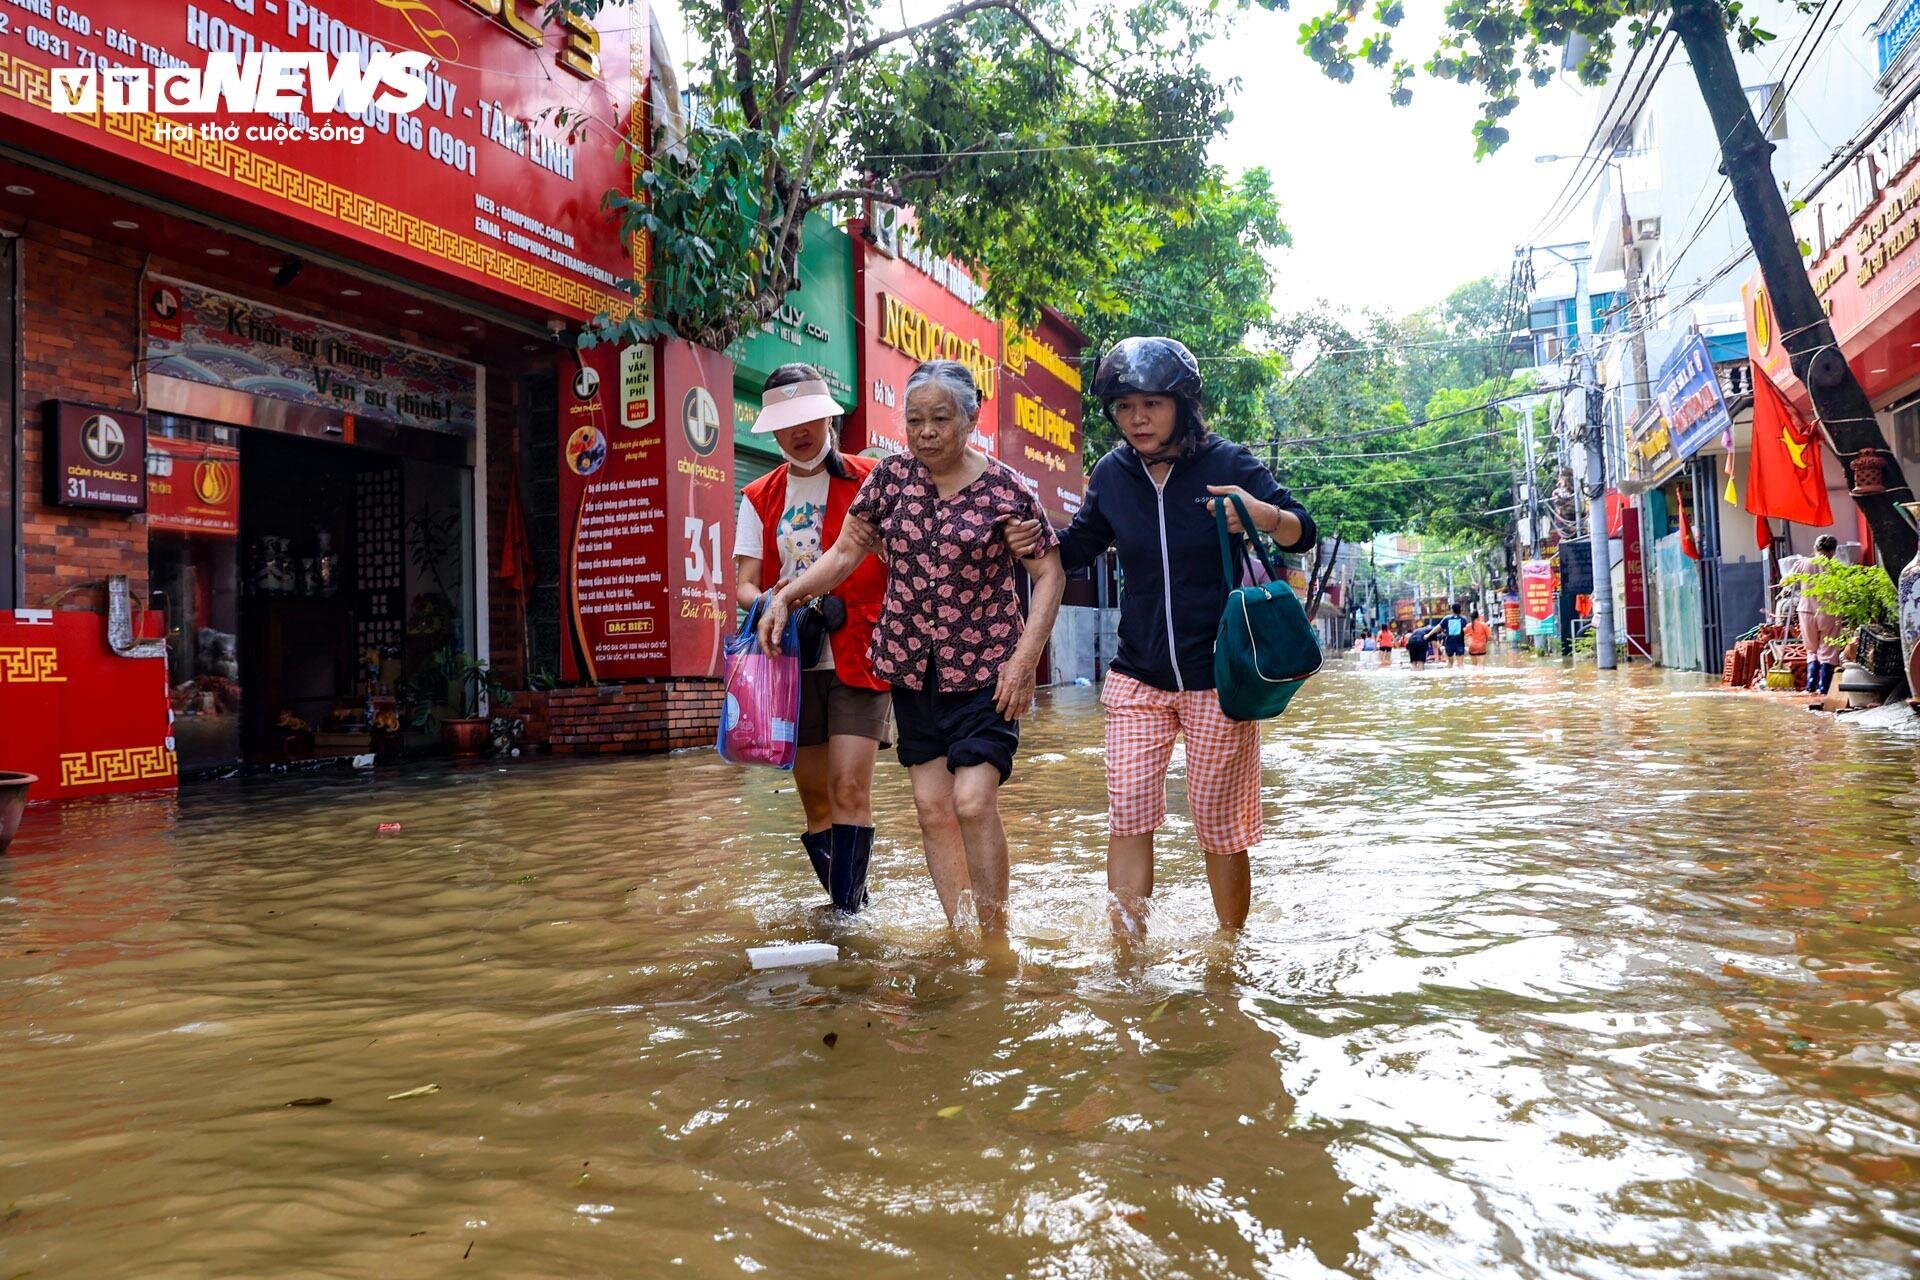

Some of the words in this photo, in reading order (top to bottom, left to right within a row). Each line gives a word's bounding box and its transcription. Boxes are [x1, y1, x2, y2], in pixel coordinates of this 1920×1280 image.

[56, 5, 91, 37] CAO
[106, 27, 138, 58] BÁT
[26, 25, 70, 61] 0931
[396, 112, 423, 151] 66
[429, 127, 476, 176] 0901
[479, 100, 526, 157] TÂM
[530, 129, 574, 181] LINH
[475, 193, 495, 215] WEB
[501, 205, 575, 250] GOMPHUOC.COM.VN
[475, 216, 502, 240] EMAIL
[631, 350, 643, 360] TƯ
[628, 361, 646, 373] VẤN
[625, 373, 650, 386] MIỄN
[629, 386, 646, 398] PHÍ
[67, 465, 92, 476] GỐM
[130, 474, 138, 482] 3
[719, 470, 726, 483] 3
[67, 478, 87, 499] 31
[684, 517, 722, 584] 31
[608, 621, 627, 633] ĐẶC
